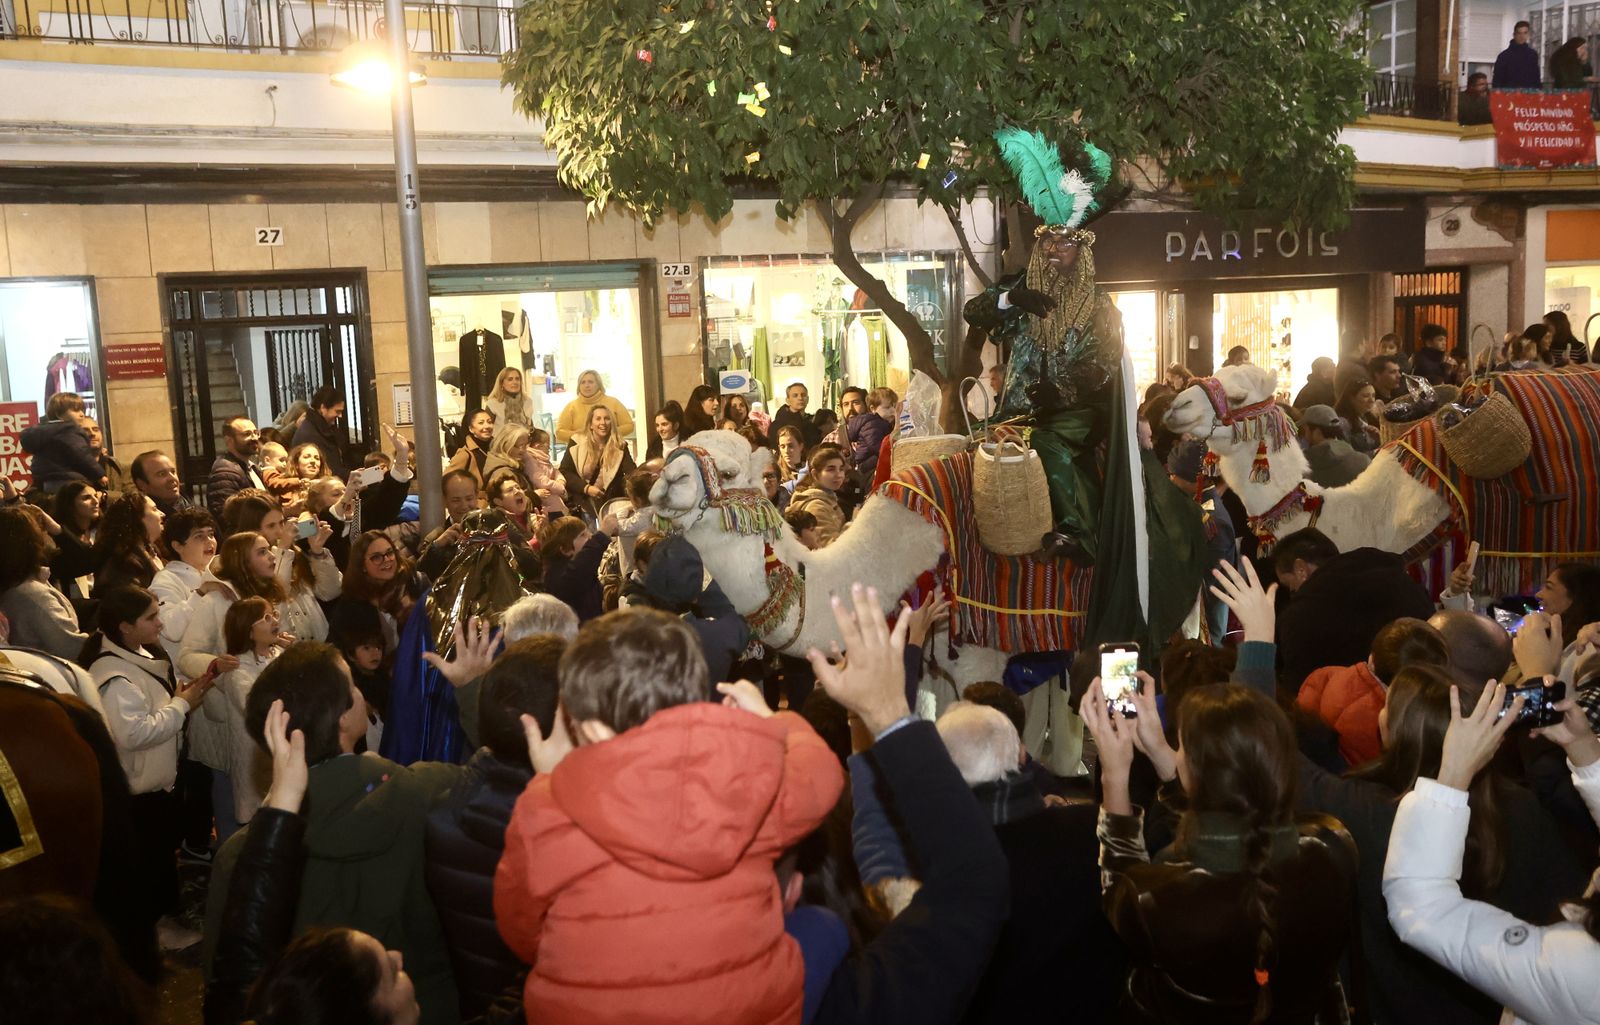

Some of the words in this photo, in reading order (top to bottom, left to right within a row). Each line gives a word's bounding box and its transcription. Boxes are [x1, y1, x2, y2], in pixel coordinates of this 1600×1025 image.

[1514, 107, 1539, 117] FELIZ
[1513, 119, 1555, 131] PRÓSPERO
[1519, 137, 1526, 147] Y
[258, 229, 280, 243] 27
[1165, 228, 1338, 262] PARFOIS
[663, 265, 678, 276] 27
[684, 265, 690, 275] B
[0, 413, 29, 433] RE
